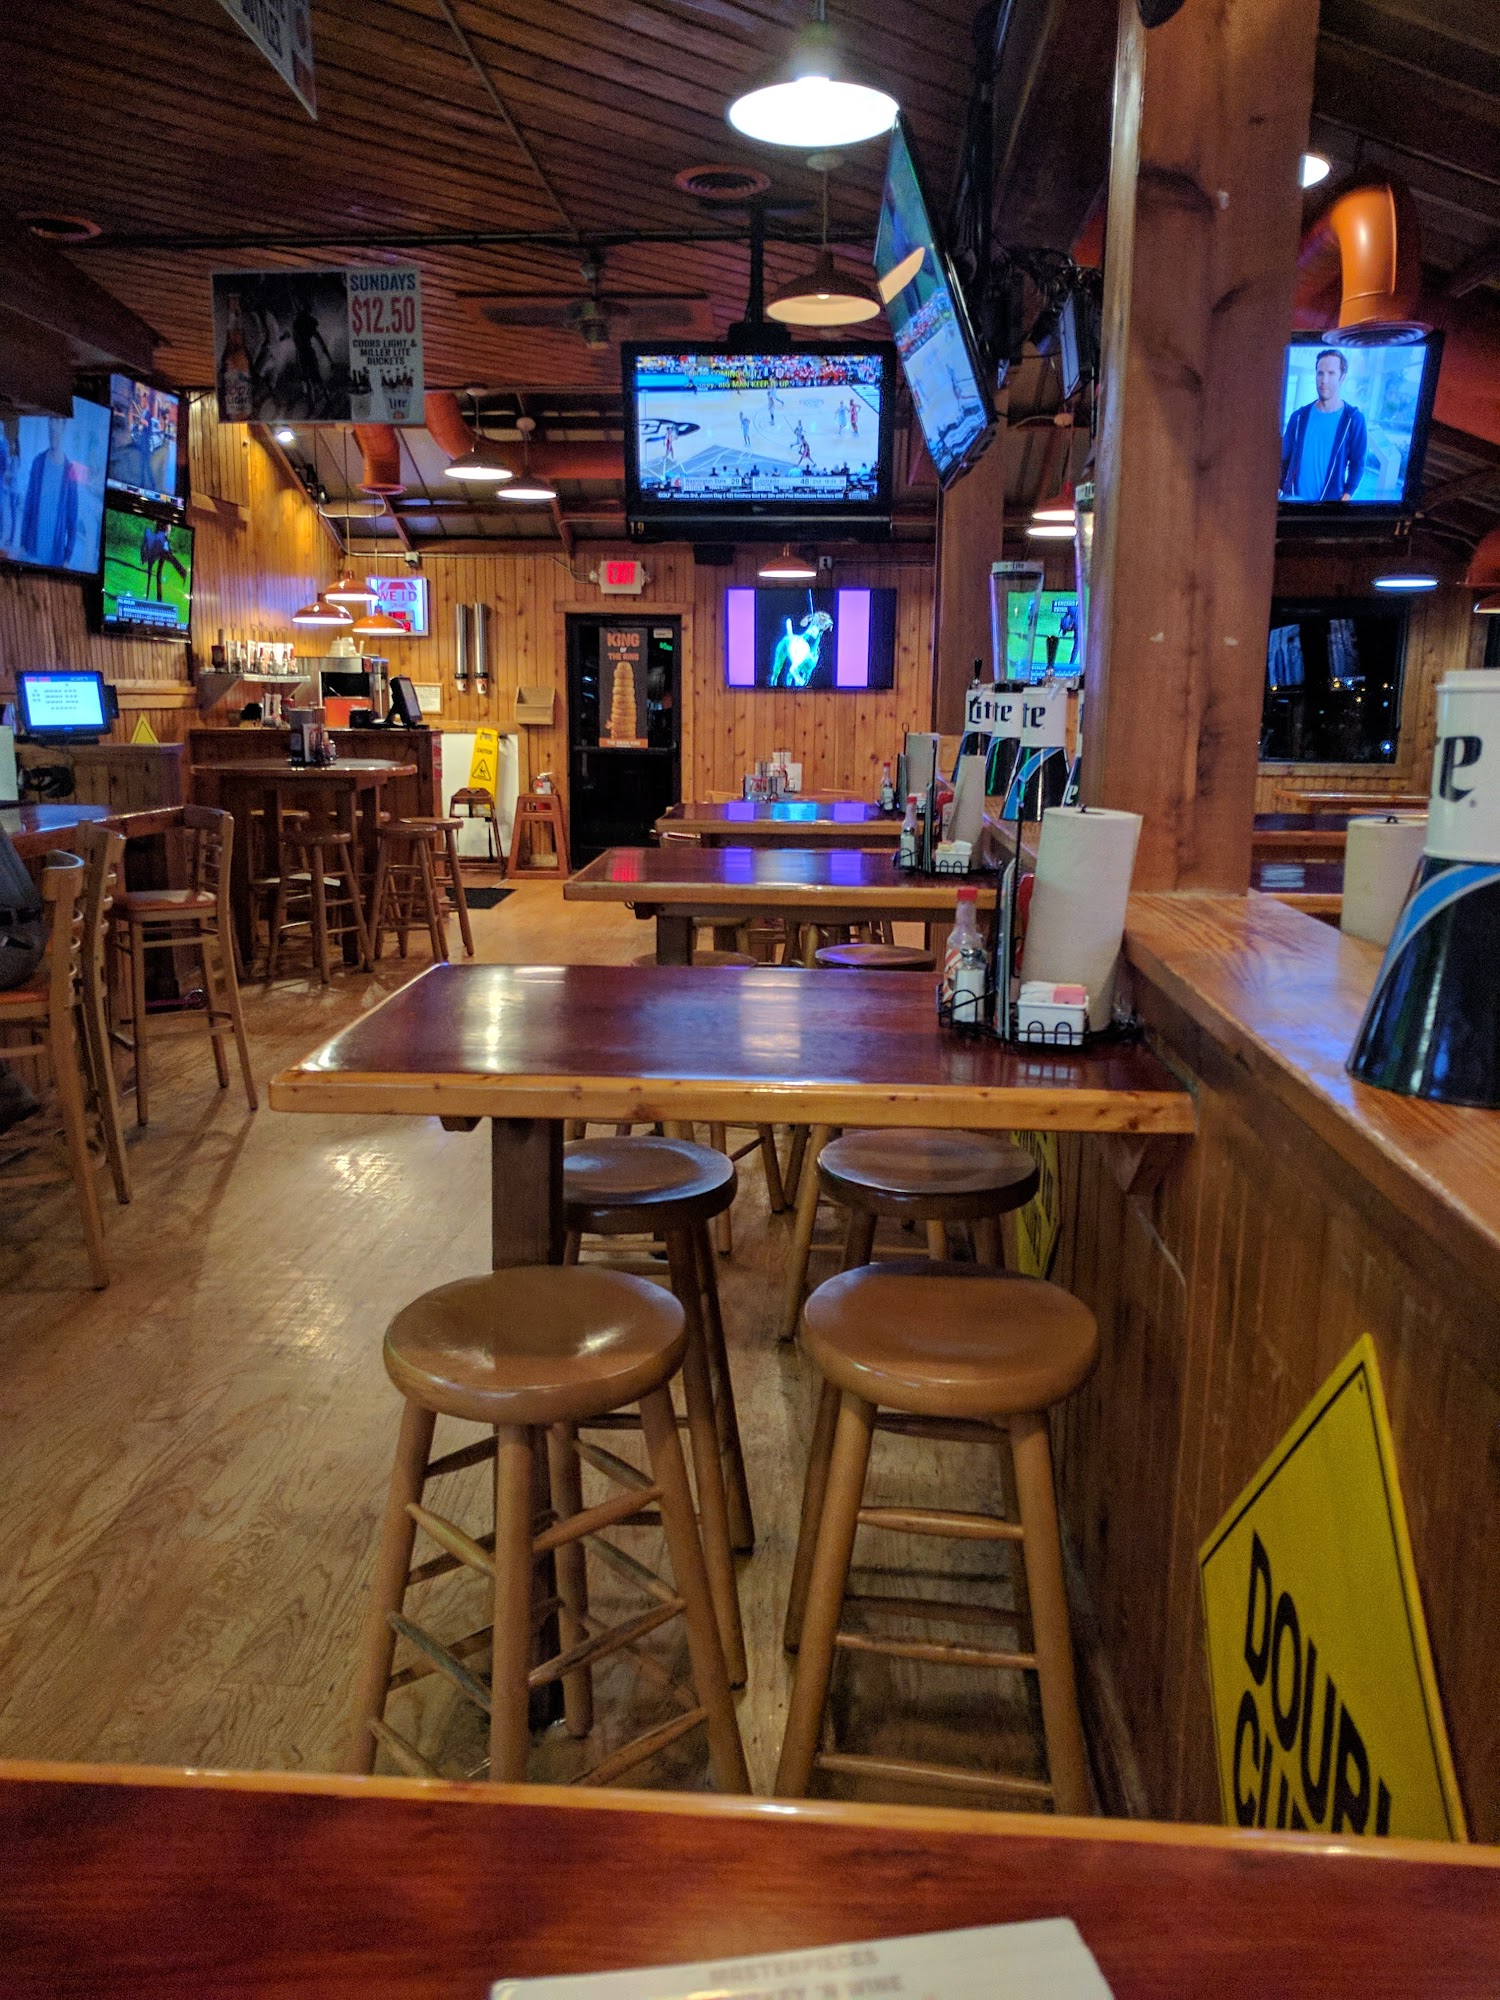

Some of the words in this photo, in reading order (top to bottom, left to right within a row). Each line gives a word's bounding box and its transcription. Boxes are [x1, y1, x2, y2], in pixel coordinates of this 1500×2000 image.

[350, 273, 416, 292] SUNDAYS
[352, 296, 416, 336] $12.50
[352, 340, 380, 349] COORS
[383, 340, 407, 348] LIGHT
[410, 339, 417, 348] &
[360, 349, 391, 357] MILLER
[393, 348, 411, 357] LITE
[367, 357, 405, 366] BUCKETS
[800, 478, 810, 486] 48
[630, 522, 645, 535] 19
[607, 561, 636, 585] EXIT
[607, 632, 640, 648] KING
